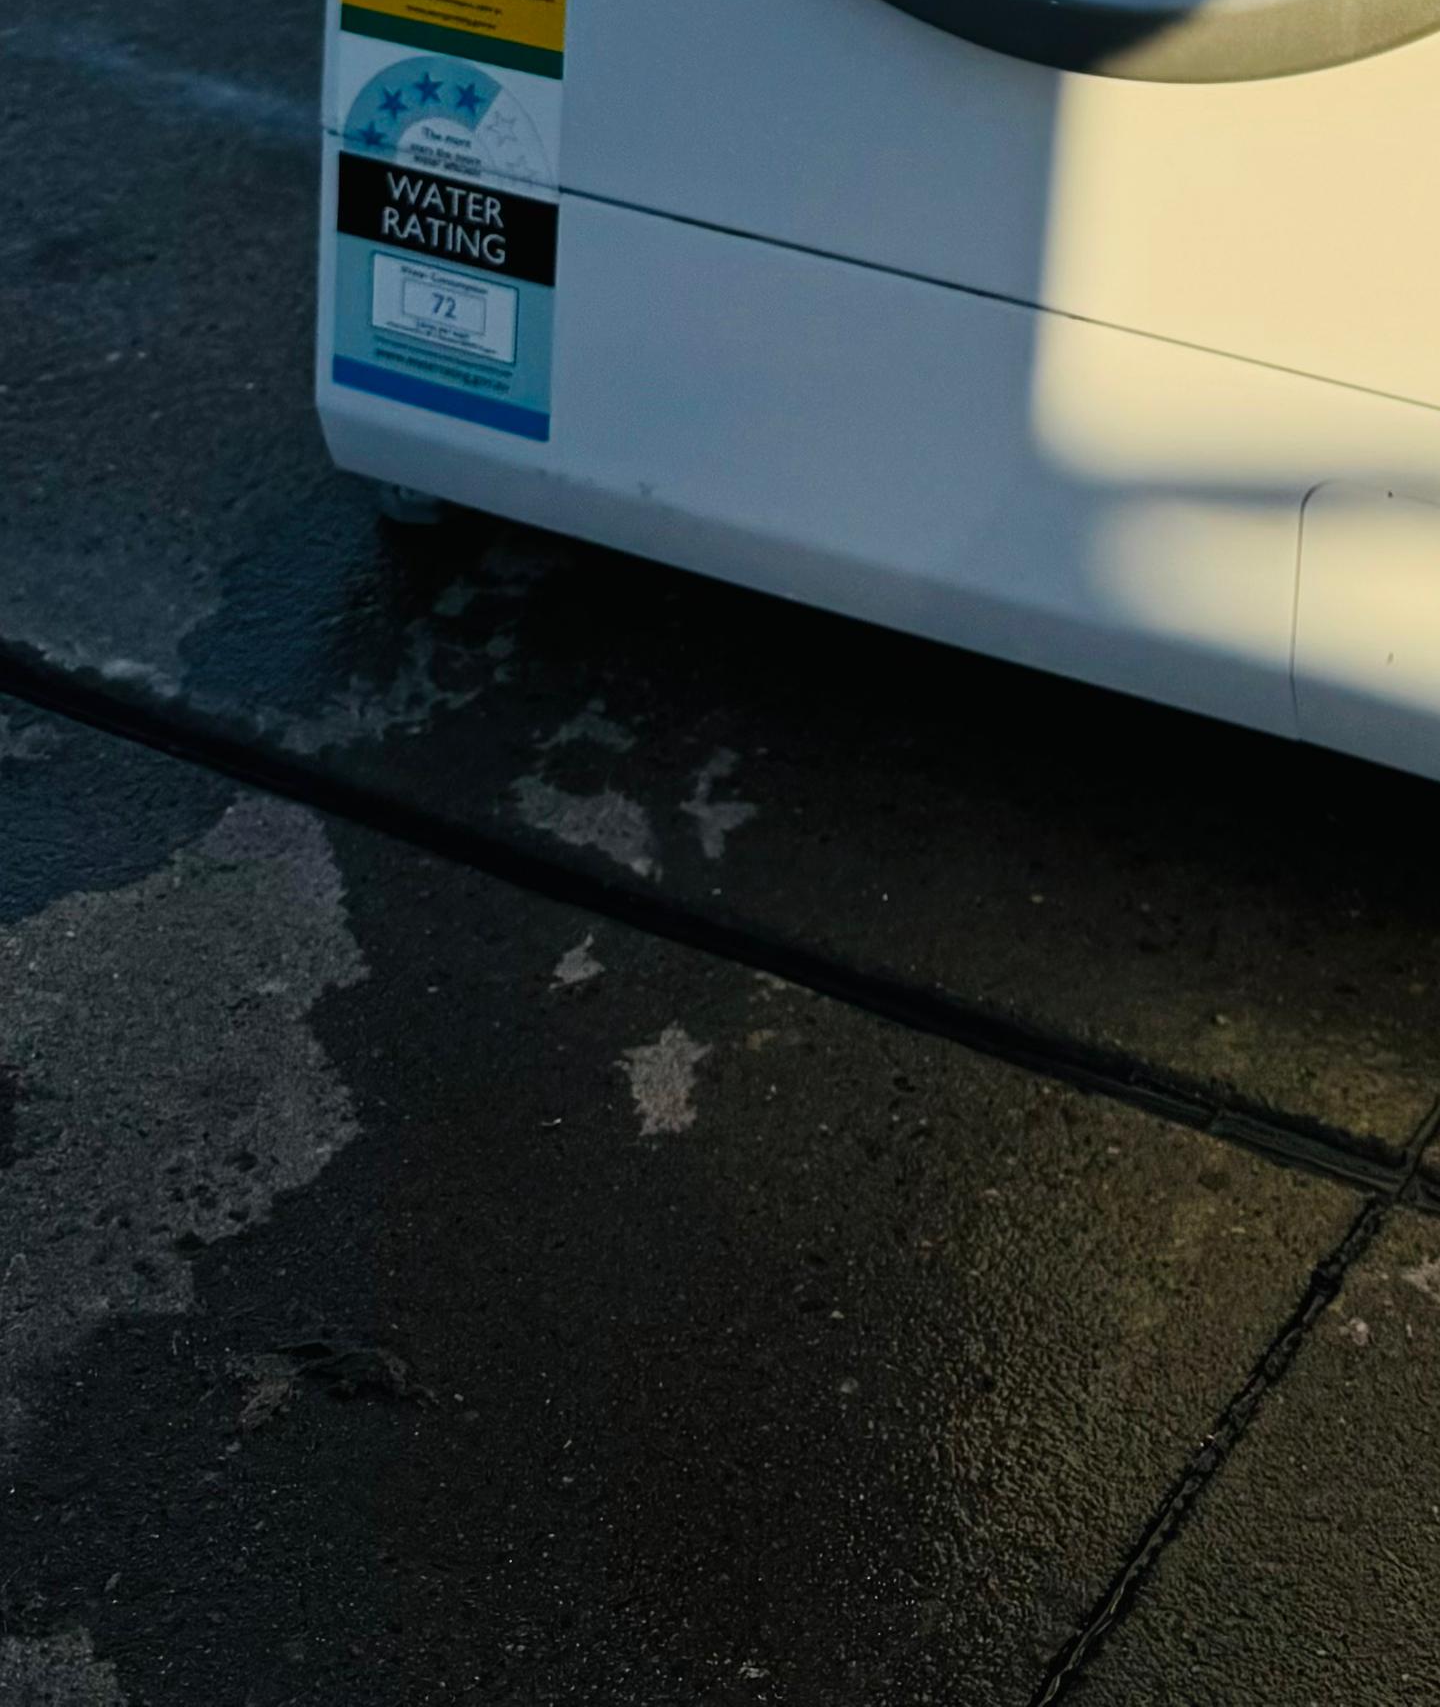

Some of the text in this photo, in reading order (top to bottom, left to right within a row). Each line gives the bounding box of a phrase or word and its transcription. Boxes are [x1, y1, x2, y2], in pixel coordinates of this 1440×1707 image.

[386, 172, 504, 229] WATER
[381, 205, 507, 265] RATING
[431, 292, 457, 319] 72
